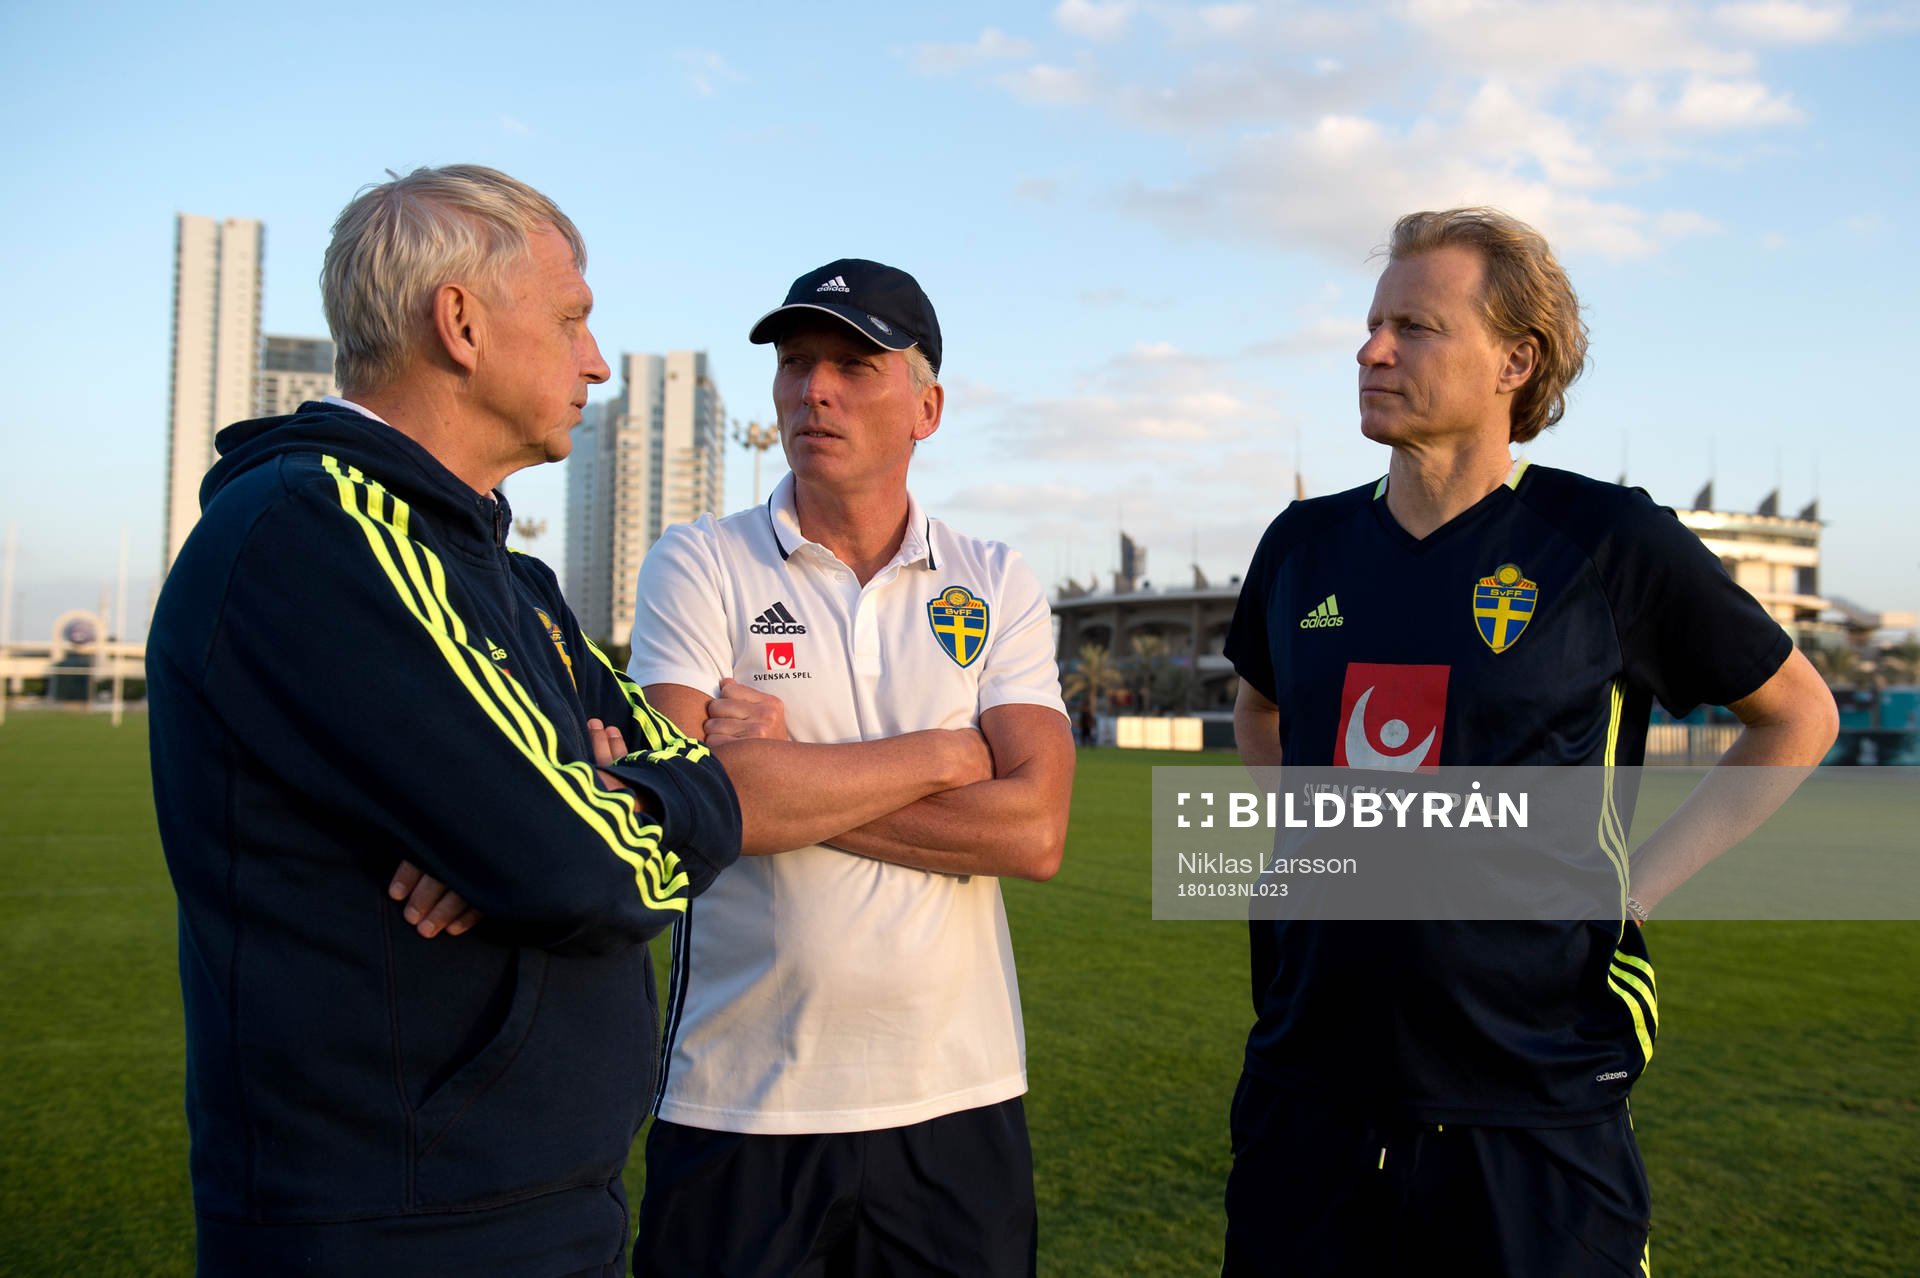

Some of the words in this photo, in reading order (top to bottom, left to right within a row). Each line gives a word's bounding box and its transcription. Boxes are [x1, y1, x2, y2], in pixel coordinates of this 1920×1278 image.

[816, 285, 850, 293] adidas
[1300, 614, 1344, 630] adidas
[750, 622, 806, 635] adidas
[753, 672, 791, 681] SVENSKA
[792, 671, 812, 679] SPEL
[1595, 1071, 1628, 1082] adizero
